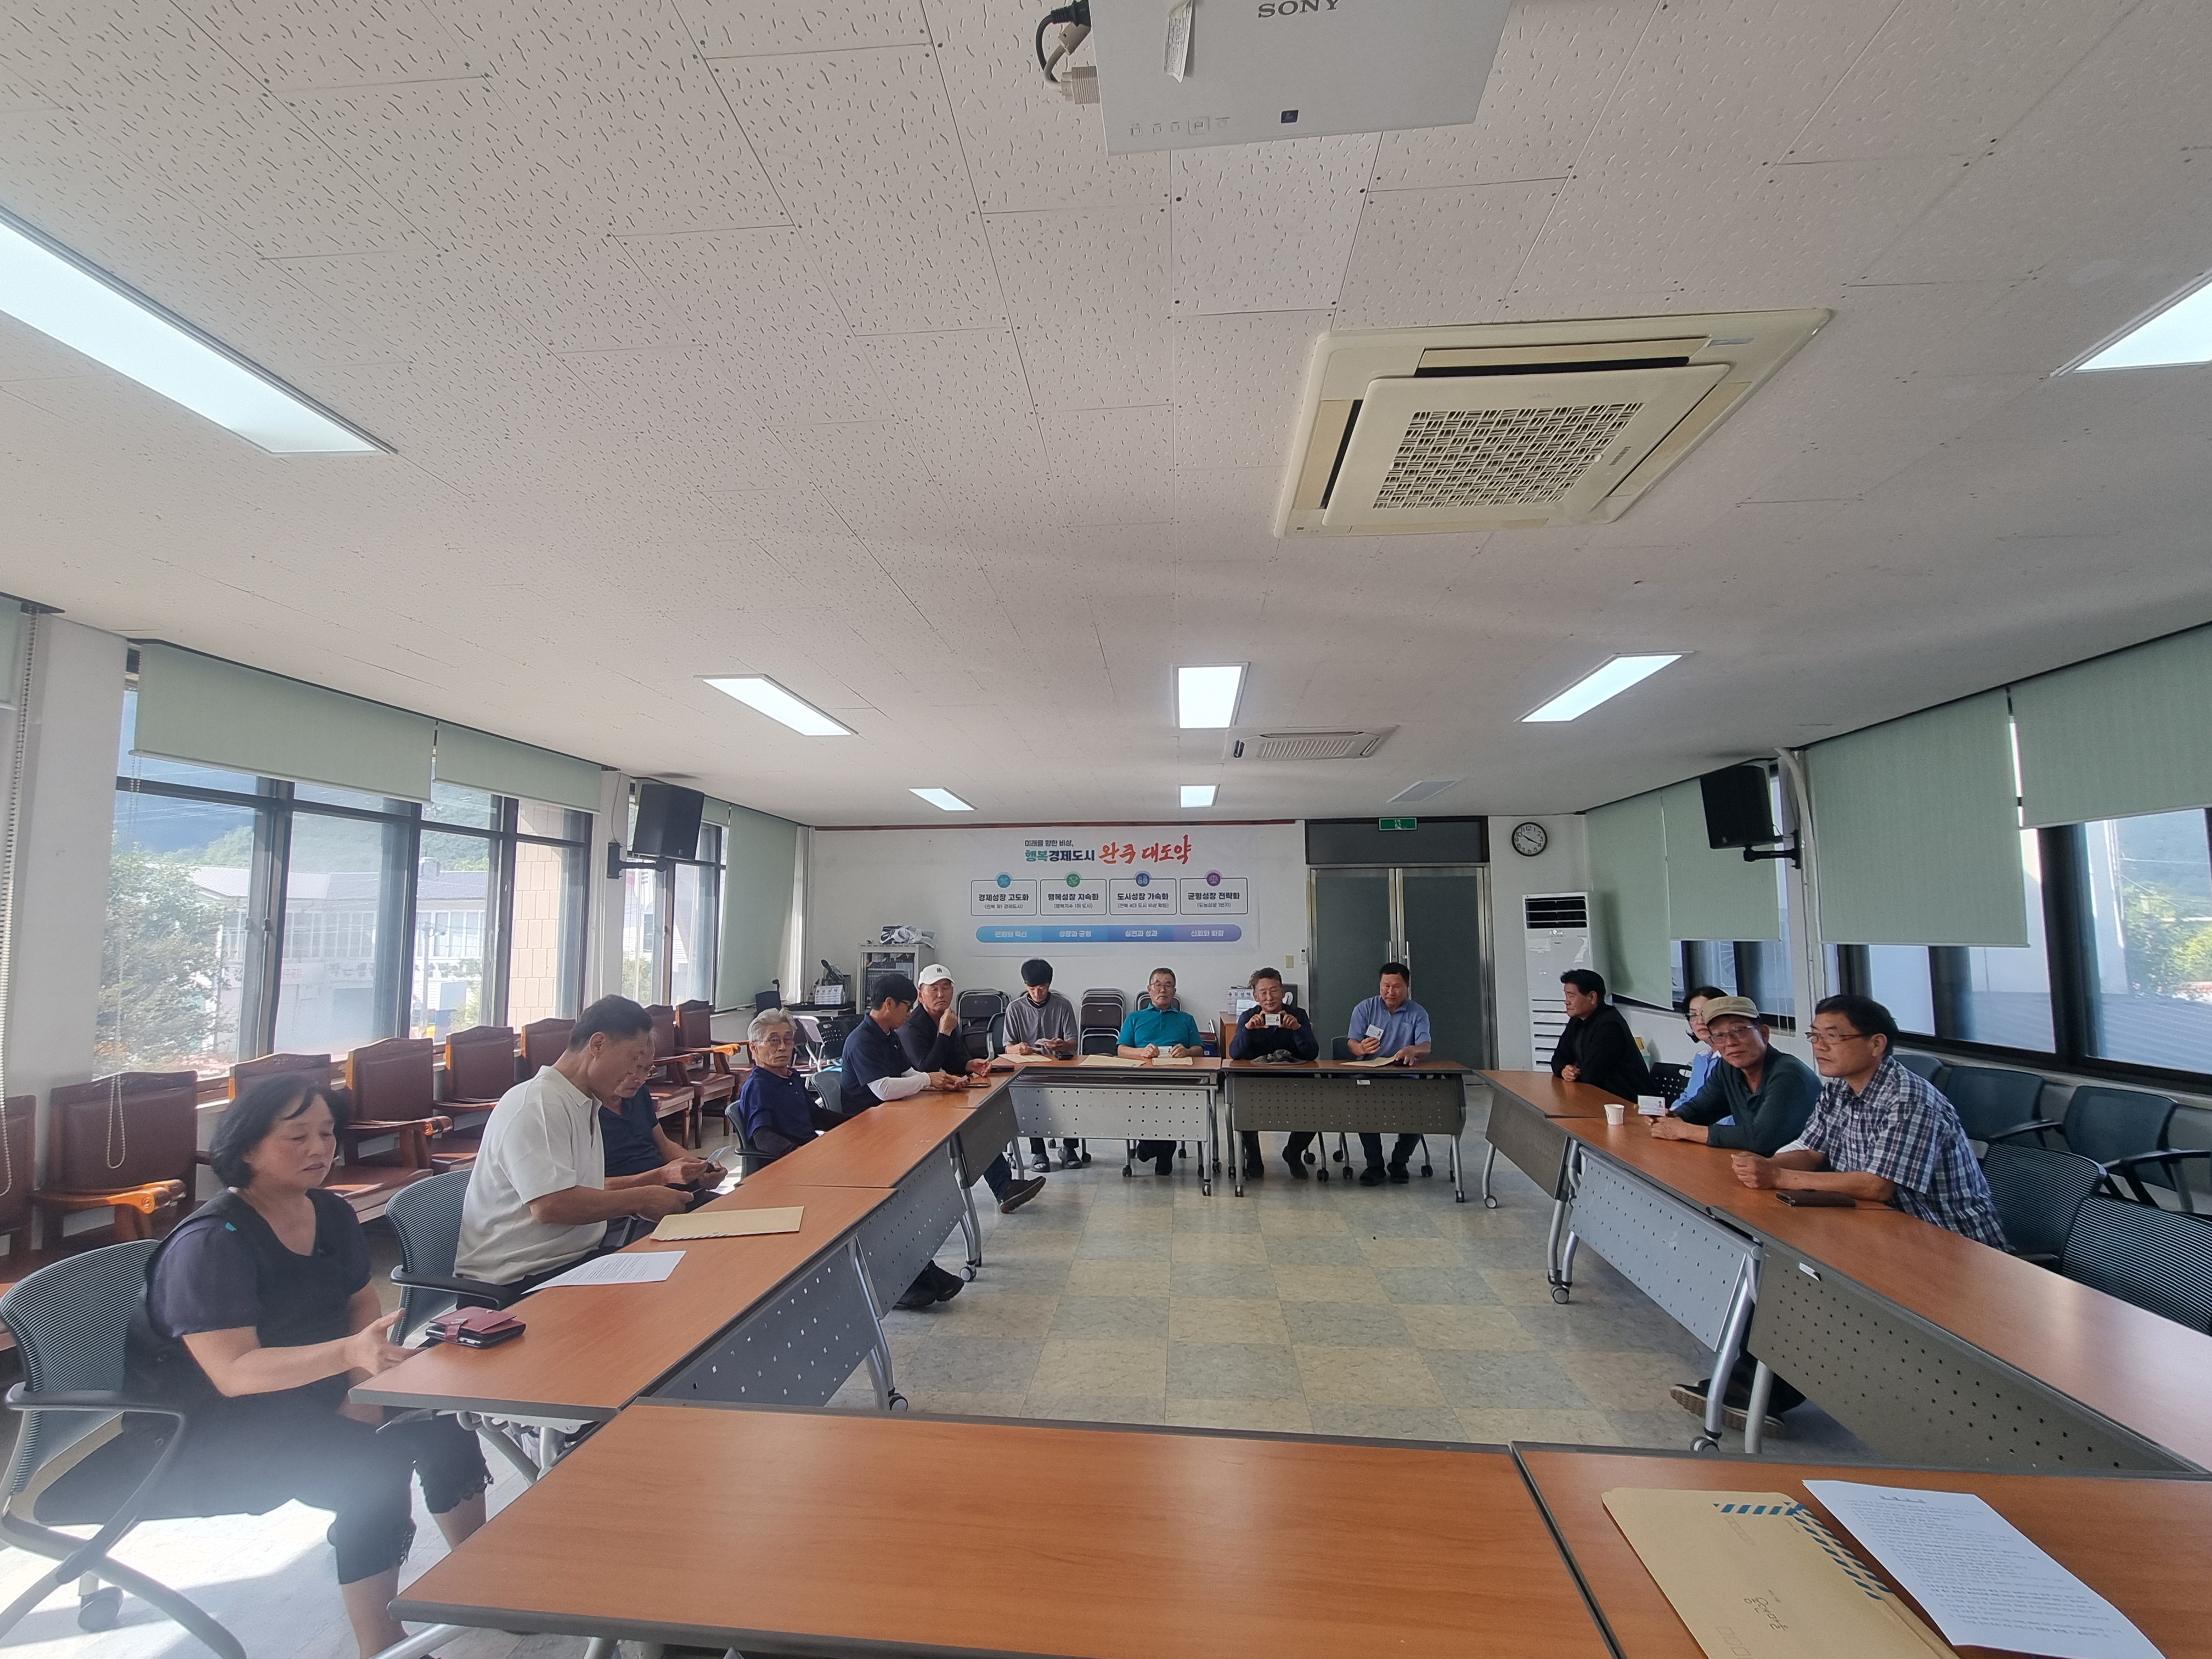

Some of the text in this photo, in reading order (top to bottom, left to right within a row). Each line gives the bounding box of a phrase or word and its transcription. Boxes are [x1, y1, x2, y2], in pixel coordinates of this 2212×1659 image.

[1258, 0, 1340, 18] SONY
[1024, 834, 1192, 865] 행복경제도시 완주 대도약
